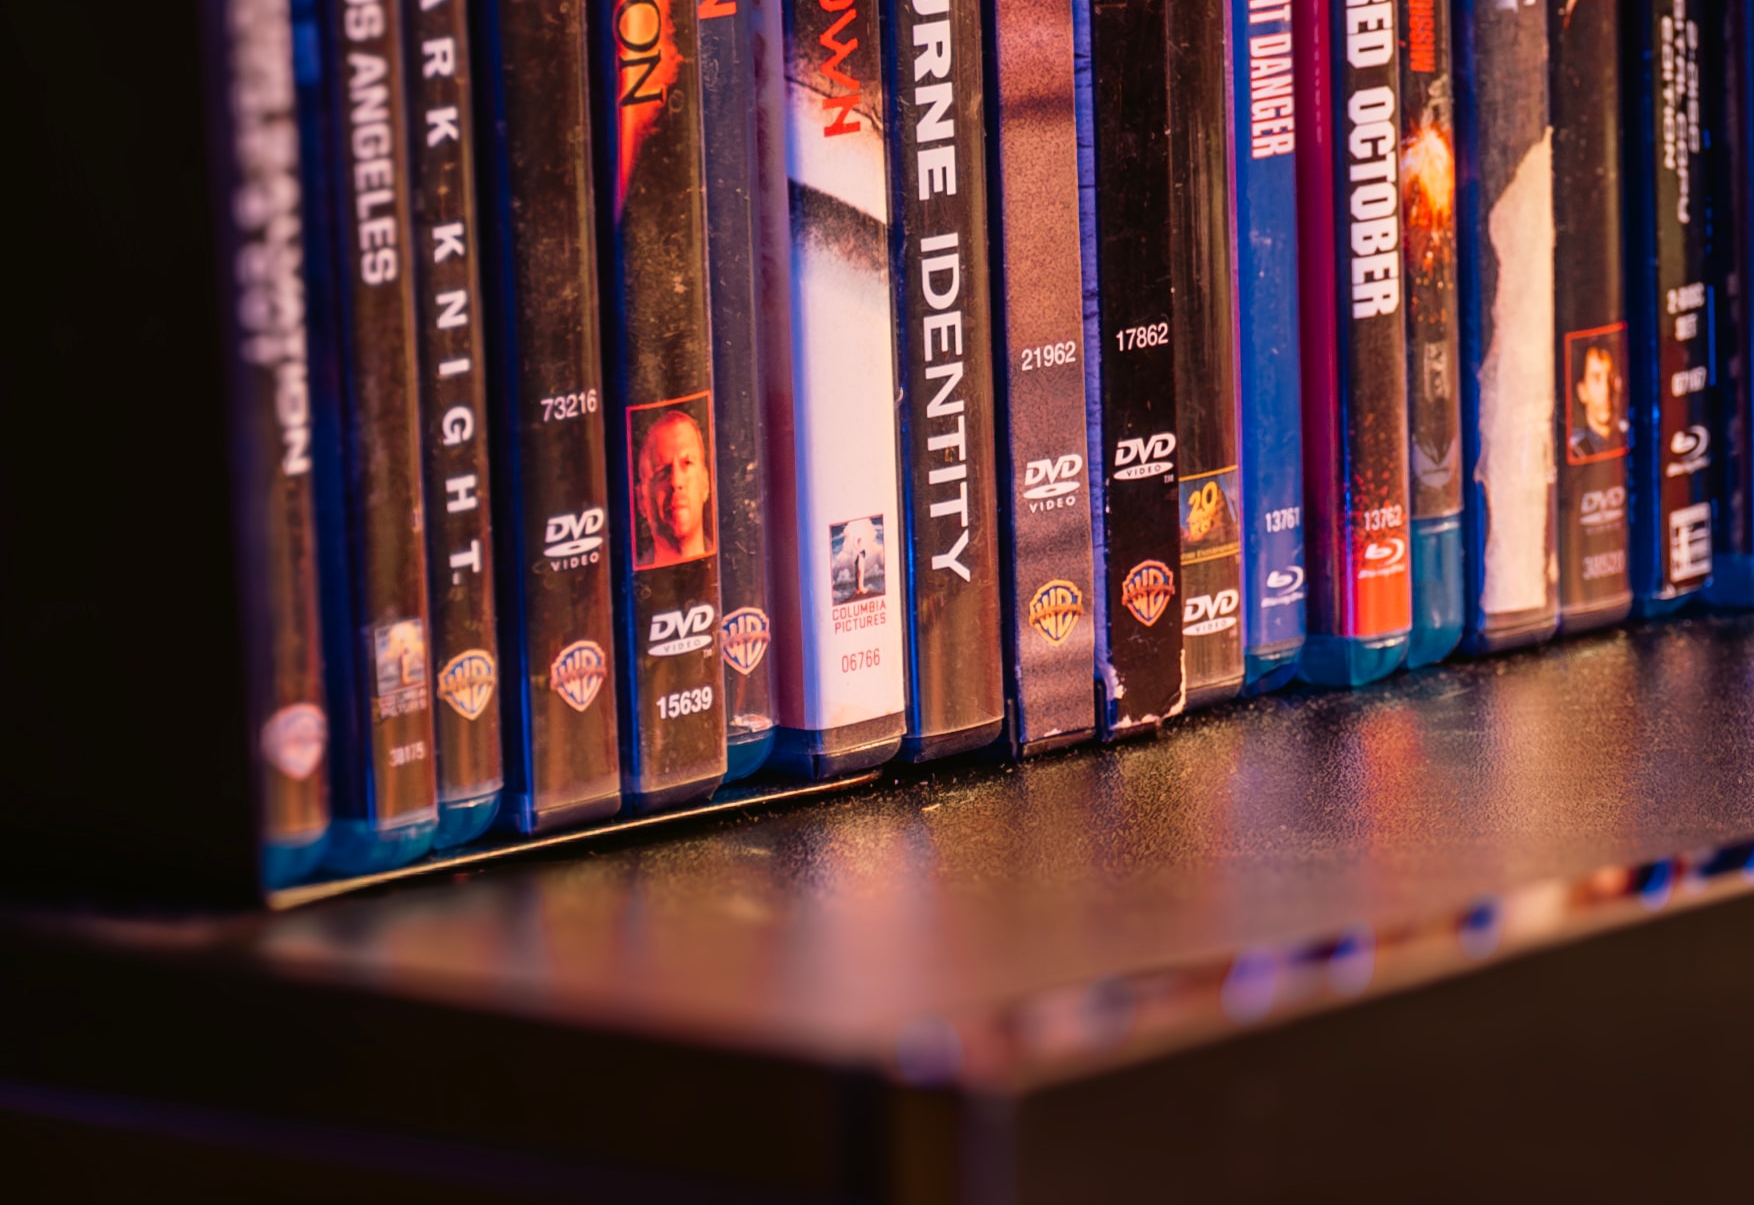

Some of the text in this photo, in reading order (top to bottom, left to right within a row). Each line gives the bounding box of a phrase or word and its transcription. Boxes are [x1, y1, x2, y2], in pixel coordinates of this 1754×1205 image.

[1249, 32, 1295, 160] DANGER
[347, 53, 398, 286] ANGELES
[1347, 86, 1400, 320] OCTOBER
[1116, 322, 1170, 352] 17862
[1021, 341, 1077, 371] 21962
[431, 221, 482, 577] KNIGHT
[541, 388, 598, 423] 73216
[919, 232, 972, 583] IDENTITY
[1114, 432, 1177, 467] DVD
[1023, 453, 1083, 486] DVD
[1125, 463, 1162, 478] VIDEO
[1029, 496, 1077, 514] VIDEO
[1265, 507, 1301, 533] 13761
[1363, 504, 1403, 532] 13762
[544, 507, 605, 544] DVD
[550, 552, 600, 572] VIDEO
[832, 599, 887, 622] COLUMBIA
[1183, 589, 1240, 623] DVD
[649, 604, 715, 642] DVD
[834, 611, 887, 635] PICTURES
[841, 648, 881, 674] 06766
[656, 685, 713, 720] 15639
